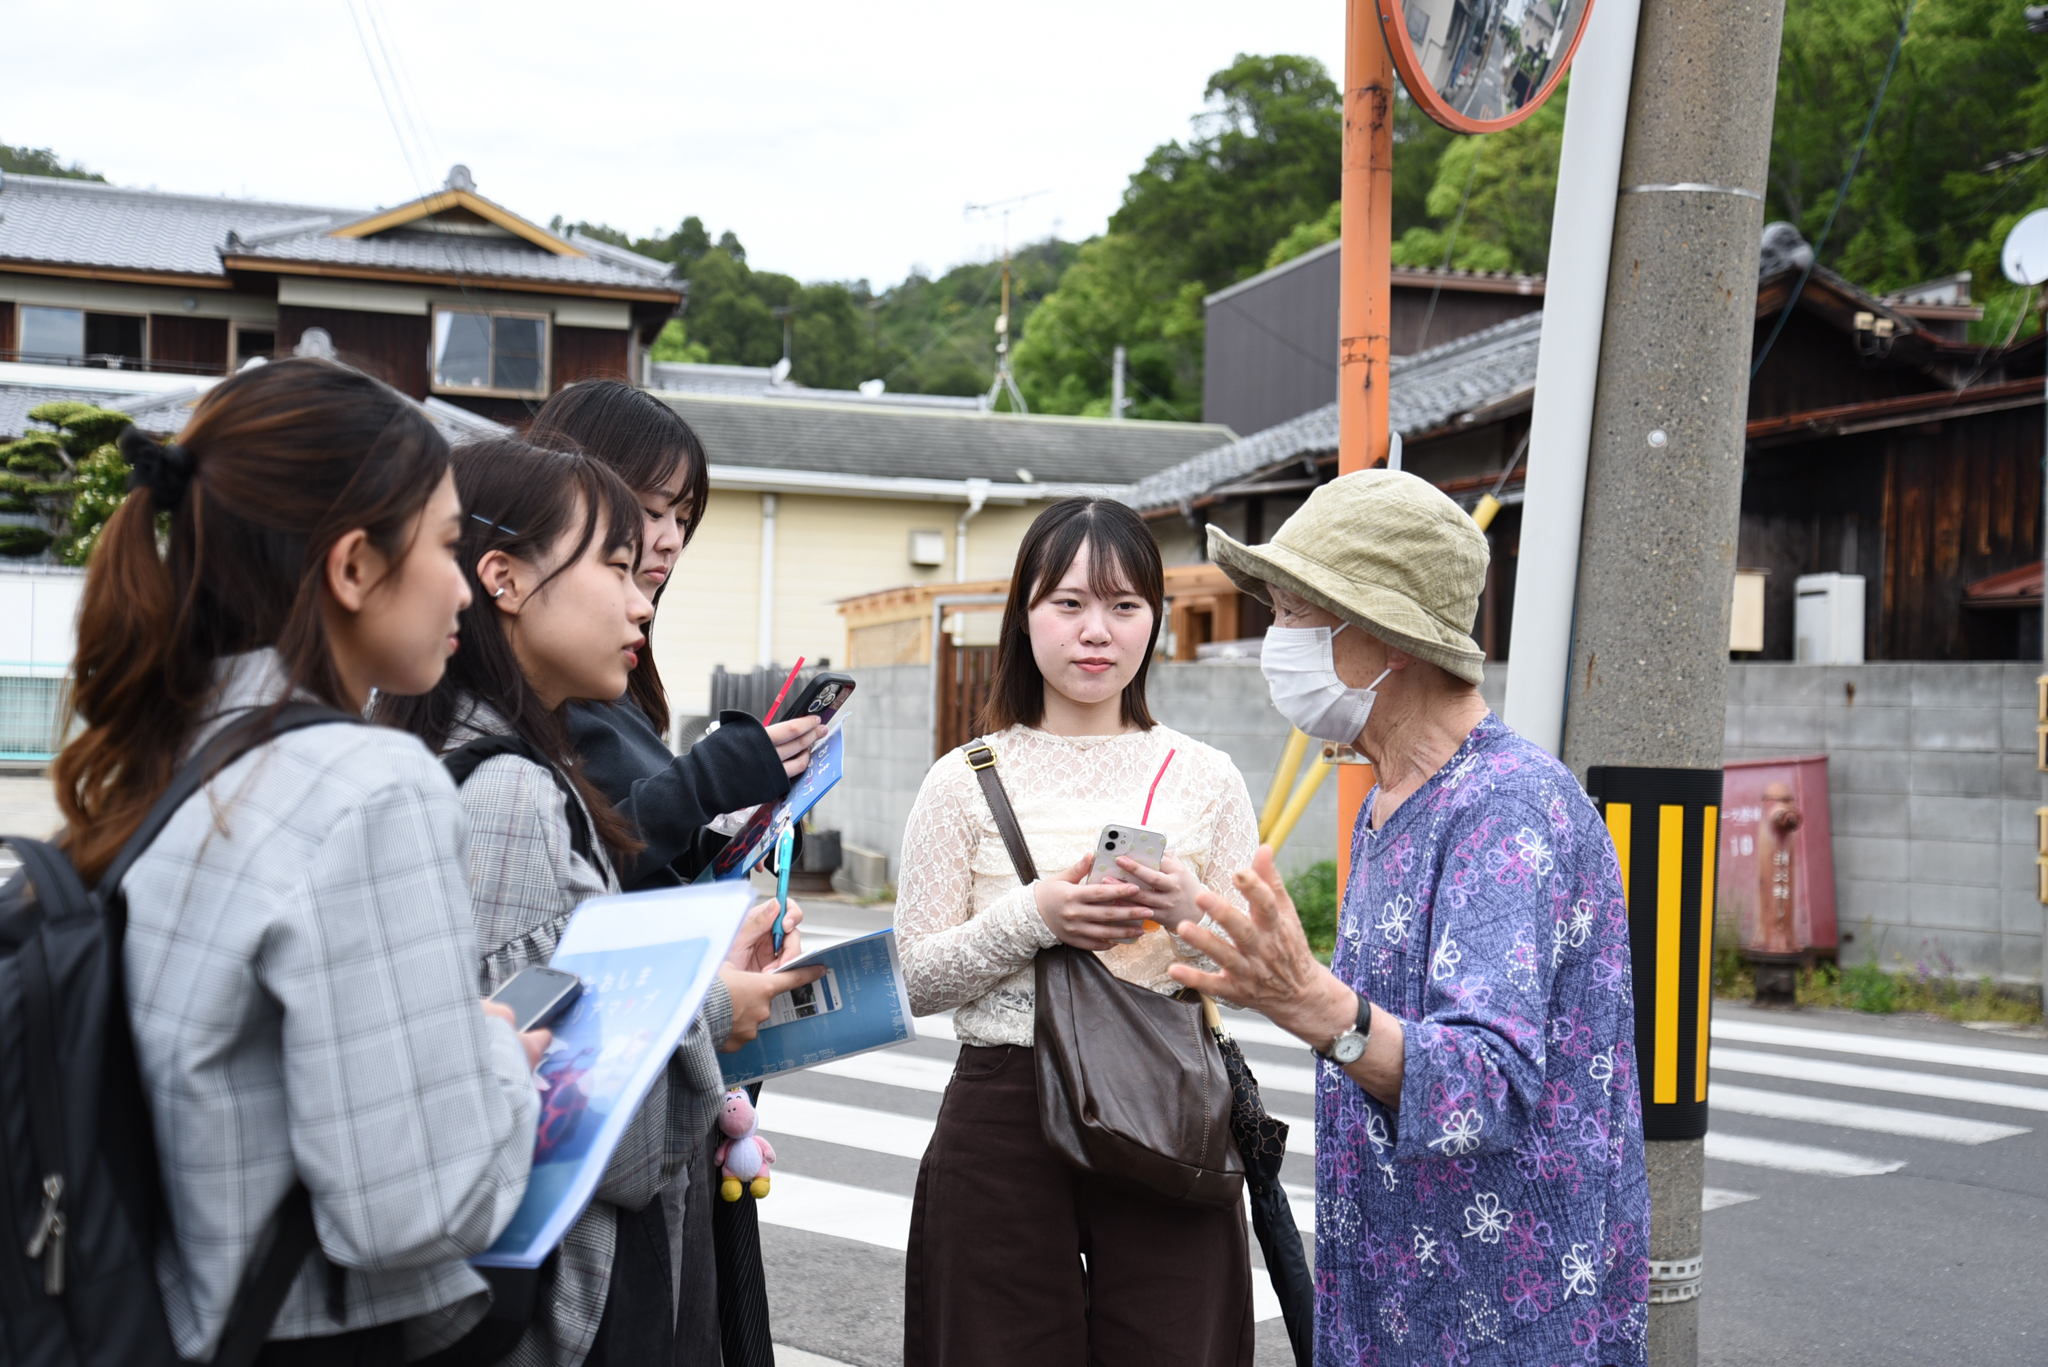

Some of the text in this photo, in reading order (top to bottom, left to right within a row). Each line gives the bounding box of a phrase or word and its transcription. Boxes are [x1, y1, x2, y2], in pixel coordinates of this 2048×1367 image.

[818, 742, 830, 776] おしま
[1730, 834, 1754, 857] 10
